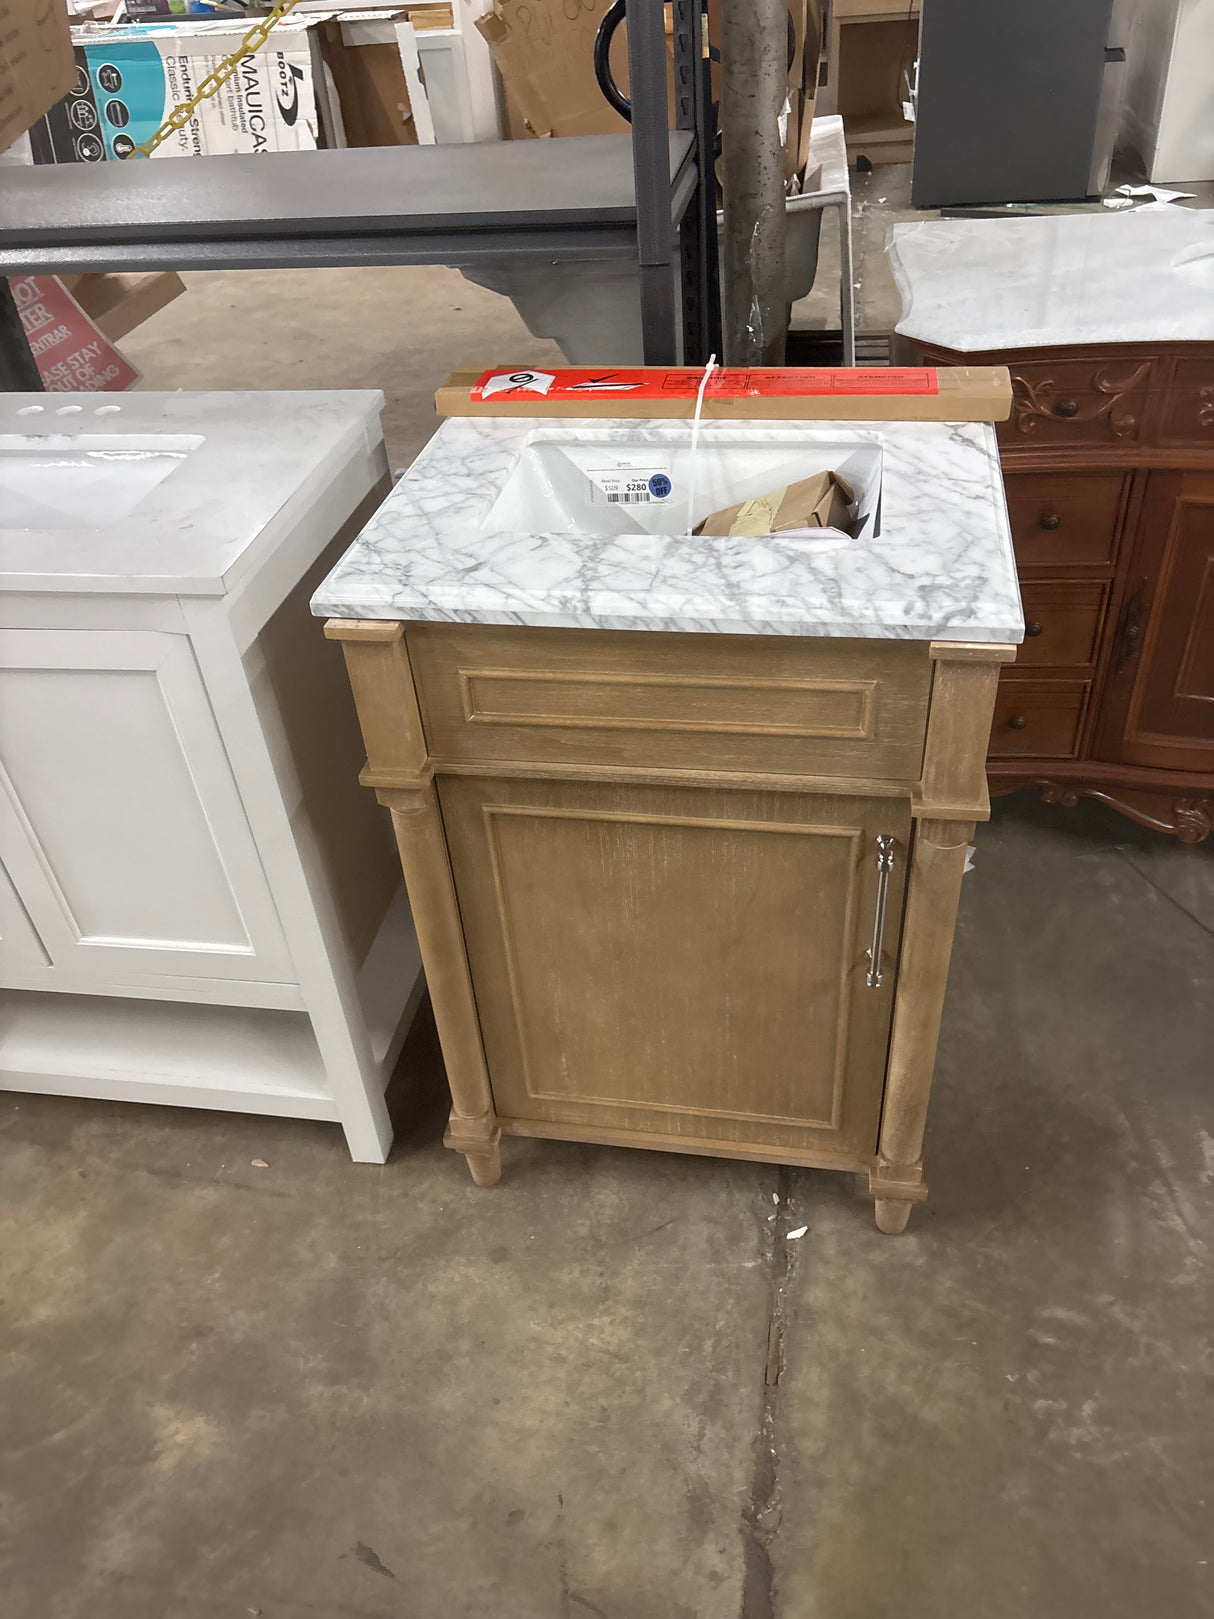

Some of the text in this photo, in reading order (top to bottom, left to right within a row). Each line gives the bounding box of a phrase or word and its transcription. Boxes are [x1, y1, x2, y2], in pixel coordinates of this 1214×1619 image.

[165, 56, 180, 101] Classic
[277, 52, 289, 97] BOOTZ
[12, 275, 42, 306] OT
[66, 341, 102, 371] STAY
[75, 363, 95, 381] OF
[626, 483, 647, 492] $280
[652, 478, 668, 487] 50%
[655, 486, 668, 496] OFF
